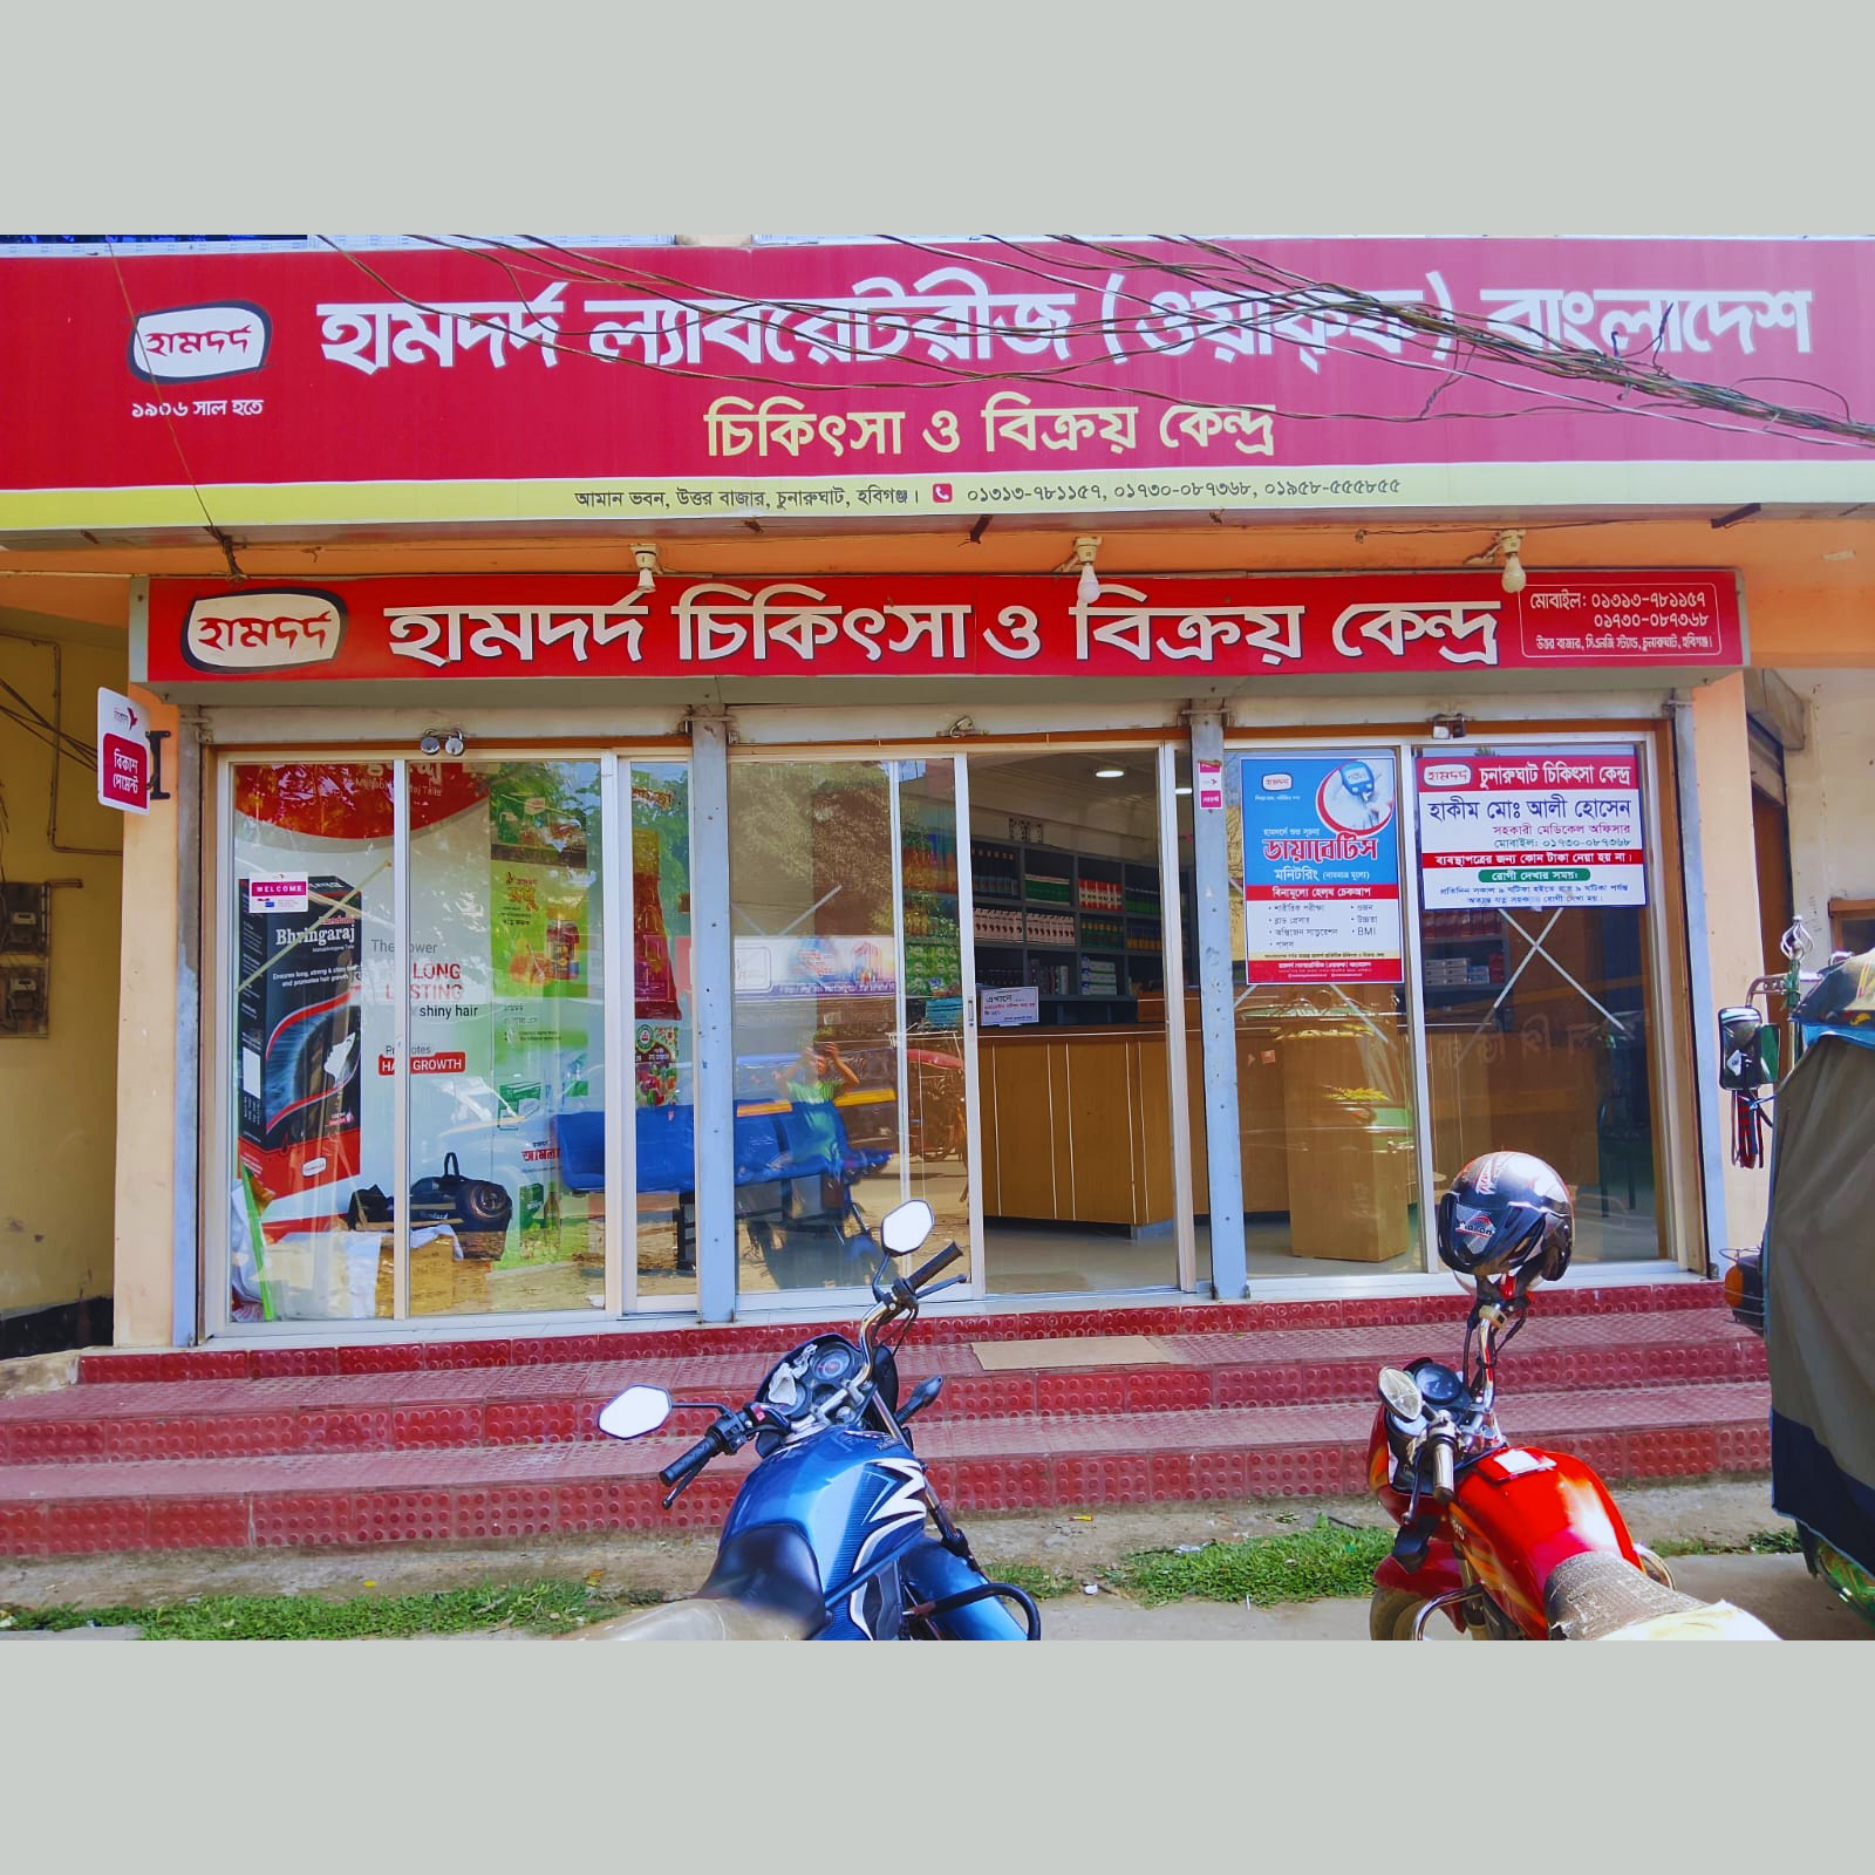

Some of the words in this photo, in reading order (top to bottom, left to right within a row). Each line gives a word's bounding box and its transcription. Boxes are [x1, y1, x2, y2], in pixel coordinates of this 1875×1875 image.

[316, 281, 569, 375] হামদর্দ
[1480, 289, 1813, 355] বাংলাদেশ
[144, 324, 252, 356] হামদর্দ
[131, 402, 188, 417] ১৯০৬
[193, 400, 227, 415] সাল
[232, 399, 264, 416] হতে
[703, 396, 905, 456] চিকিৎসা
[922, 411, 960, 453] ও
[982, 391, 1138, 454] বিক্রয়
[1159, 404, 1276, 456] কেন্দ্র
[575, 492, 624, 507] আমান
[630, 492, 670, 508] ভবন,
[676, 488, 712, 507] উত্তর
[720, 491, 770, 509] বাজার,
[777, 488, 850, 510] চুনারুঘাট,
[967, 485, 1107, 503] ০১৩১৩-৭৮১১৫৭,
[1114, 481, 1257, 499] ০১৭৩০-০৮৭৩৬৮,
[1265, 478, 1400, 496] ০১৯৫৮-৫৫৫৮৫৫
[1592, 591, 1706, 608] ০১৩১৩-৭৮১১৫৭
[198, 610, 331, 651] হামদর্দ
[383, 587, 649, 667] হামদর্দ
[671, 583, 972, 661] চিকিৎসা
[982, 605, 1041, 660] ও
[1069, 584, 1305, 666] বিক্রয়
[1332, 601, 1500, 666] কেন্দ্র
[1594, 612, 1709, 628] ০১৭৩০-০৮৭৩৬৮
[1479, 762, 1539, 790] চুনারুঘাট
[1543, 760, 1594, 785] চিকিৎসা
[1599, 766, 1631, 786] কেন্দ্র
[1428, 795, 1480, 821] হাকীম
[1487, 800, 1521, 819] মোঃ
[1527, 793, 1567, 818] আলী
[1575, 800, 1631, 819] হোসেন
[1262, 832, 1379, 863] ডায়াবেটিস
[1357, 926, 1377, 936] BMI
[371, 940, 395, 953] The
[409, 941, 438, 953] ower
[413, 962, 461, 979] LONG
[386, 984, 463, 1000] LSTING
[420, 1005, 452, 1020] shiny
[456, 1004, 478, 1017] hair
[413, 1058, 462, 1071] GROWTH
